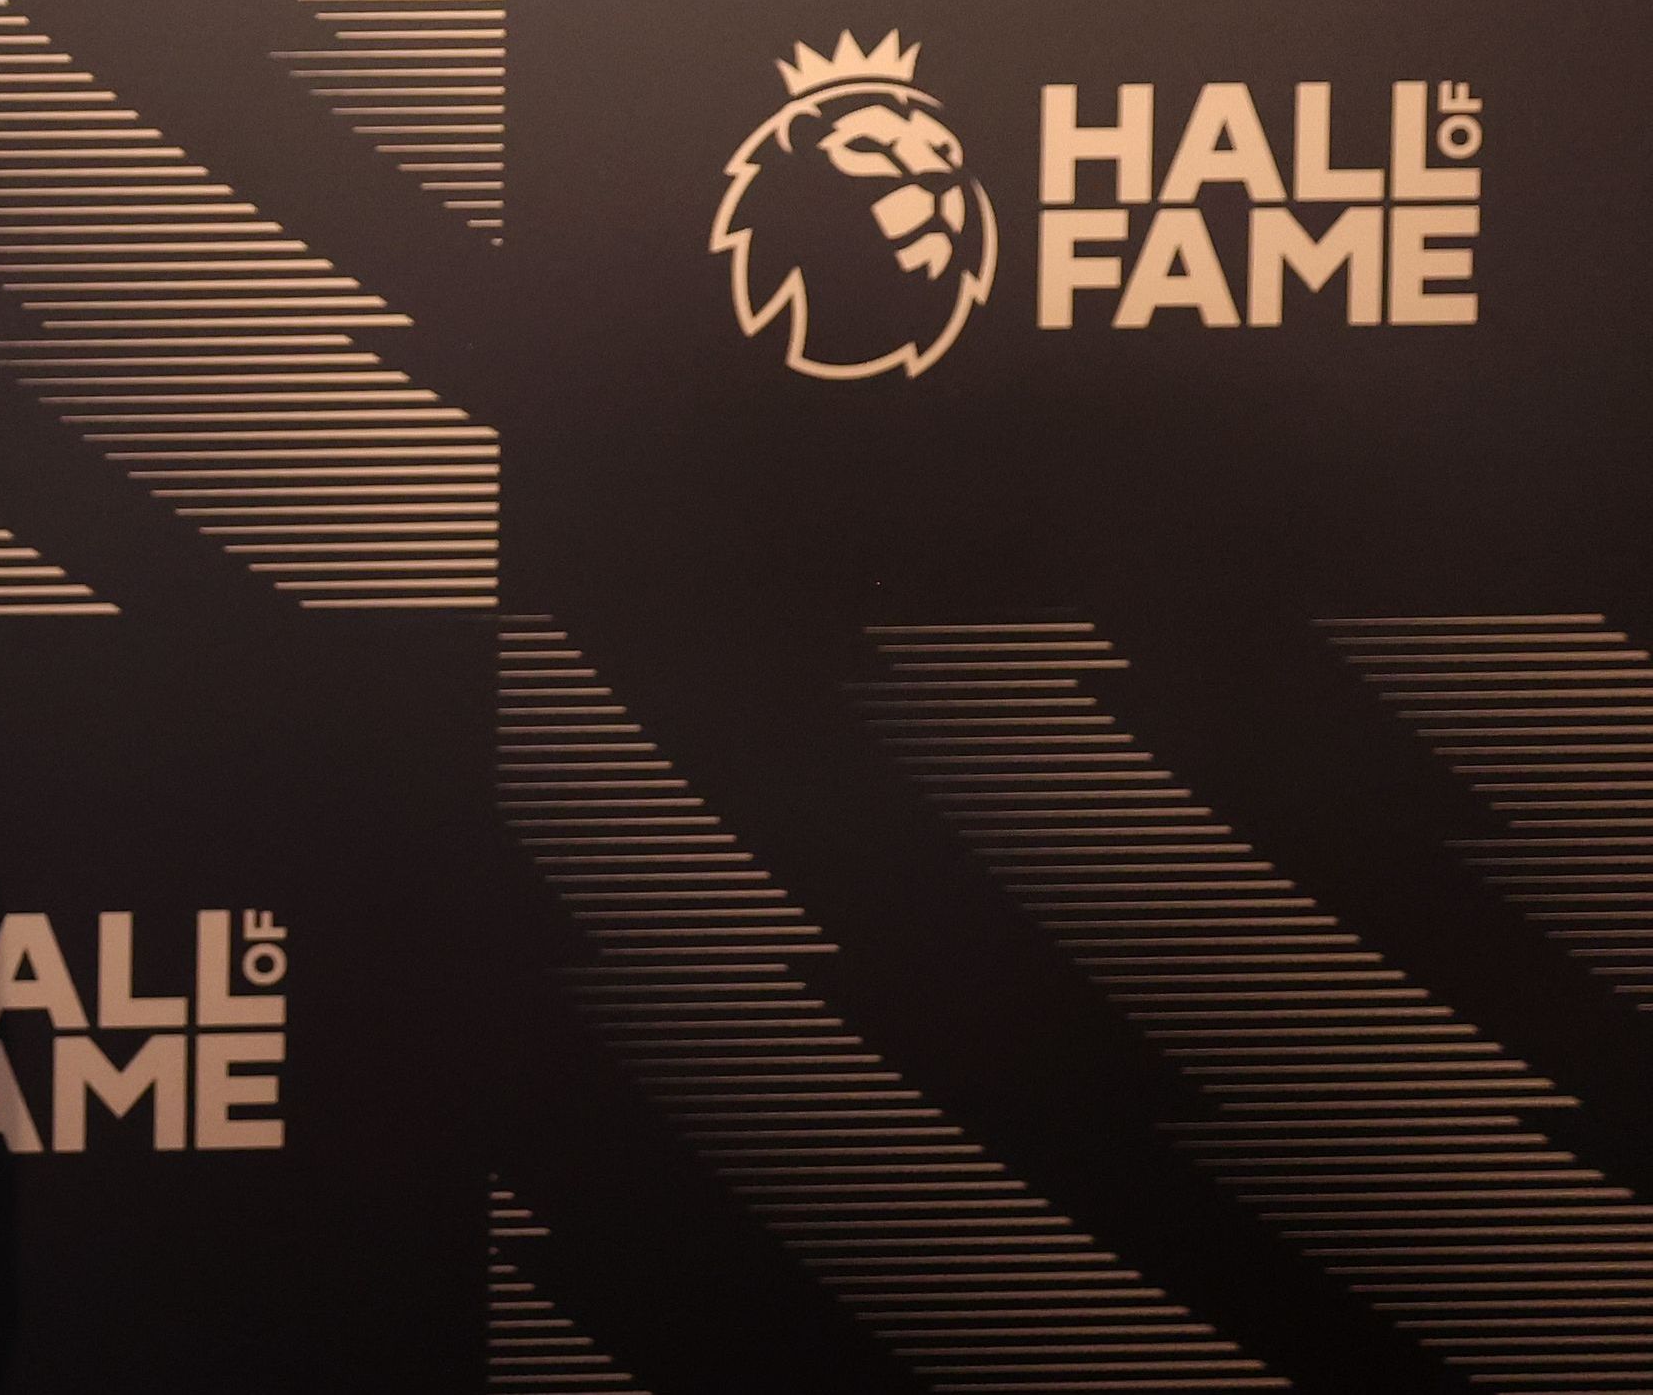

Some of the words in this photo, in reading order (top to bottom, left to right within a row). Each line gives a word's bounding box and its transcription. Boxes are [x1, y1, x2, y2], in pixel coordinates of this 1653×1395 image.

[1039, 80, 1482, 205] HALL
[1437, 79, 1483, 160] OF
[1037, 206, 1481, 330] FAME
[242, 908, 287, 986] OF
